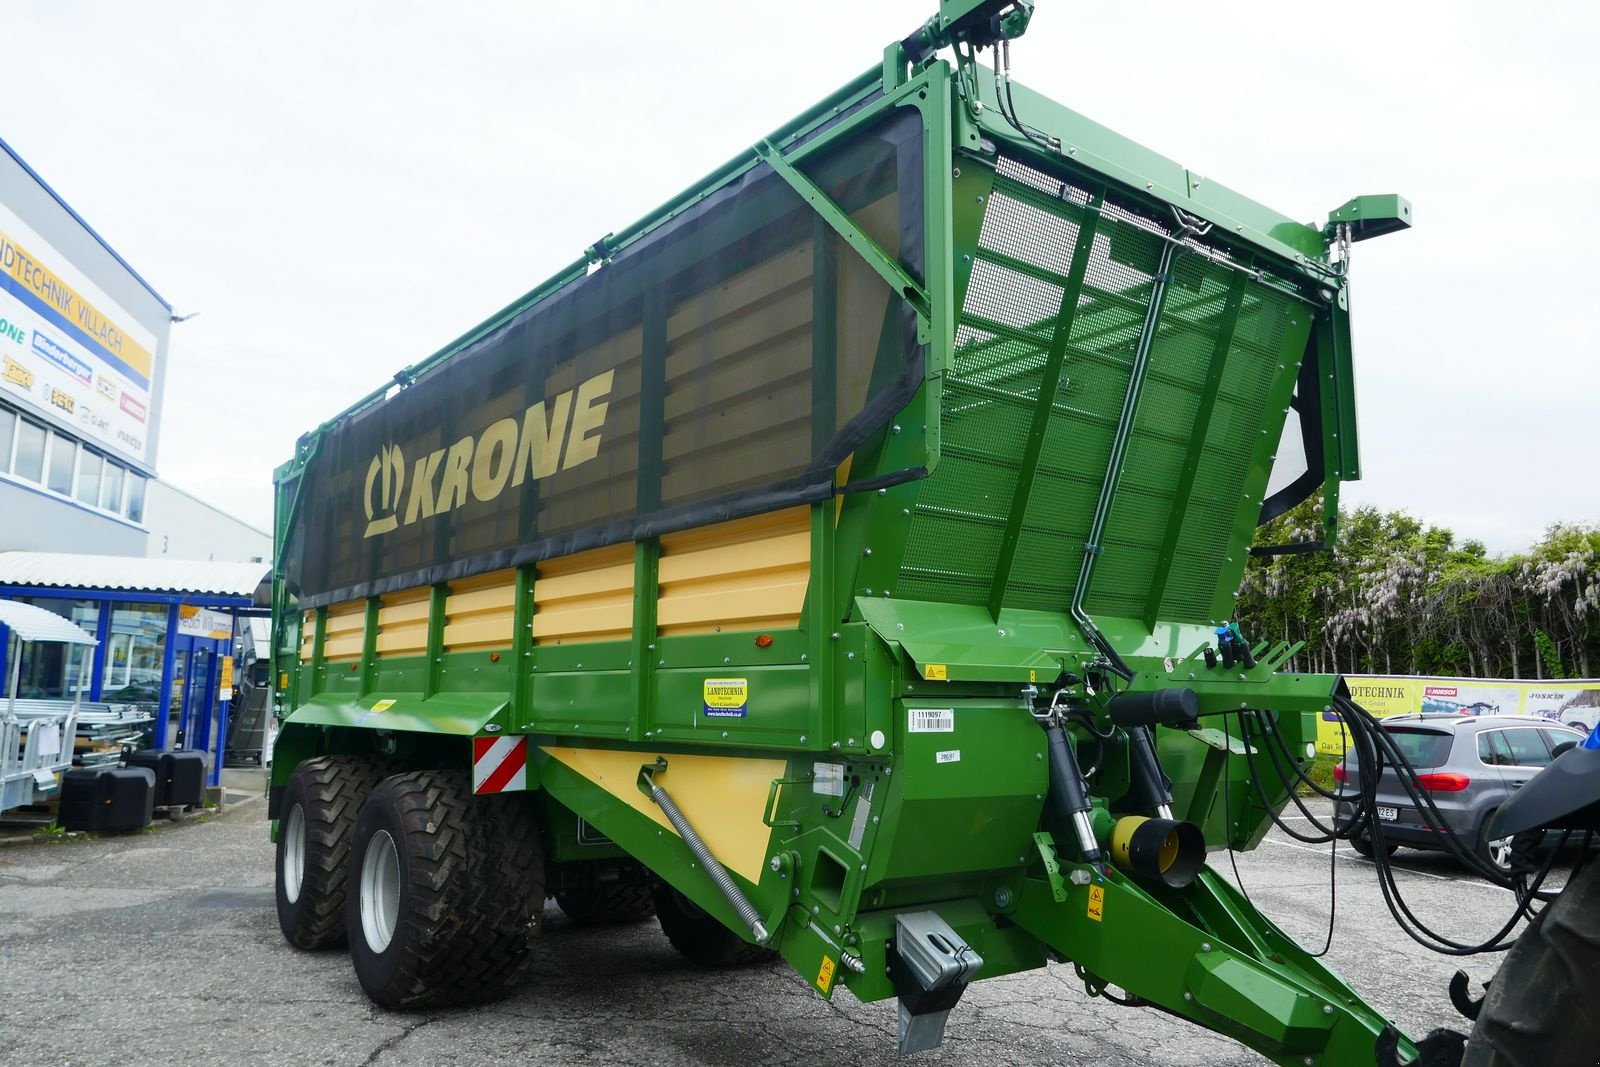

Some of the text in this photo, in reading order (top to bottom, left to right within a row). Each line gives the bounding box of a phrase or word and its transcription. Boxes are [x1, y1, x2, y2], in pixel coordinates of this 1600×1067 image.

[78, 300, 123, 352] VILLACH
[403, 369, 615, 526] KRONE
[707, 687, 743, 695] LANDTECHNIK
[1348, 686, 1405, 699] DTECHNIK
